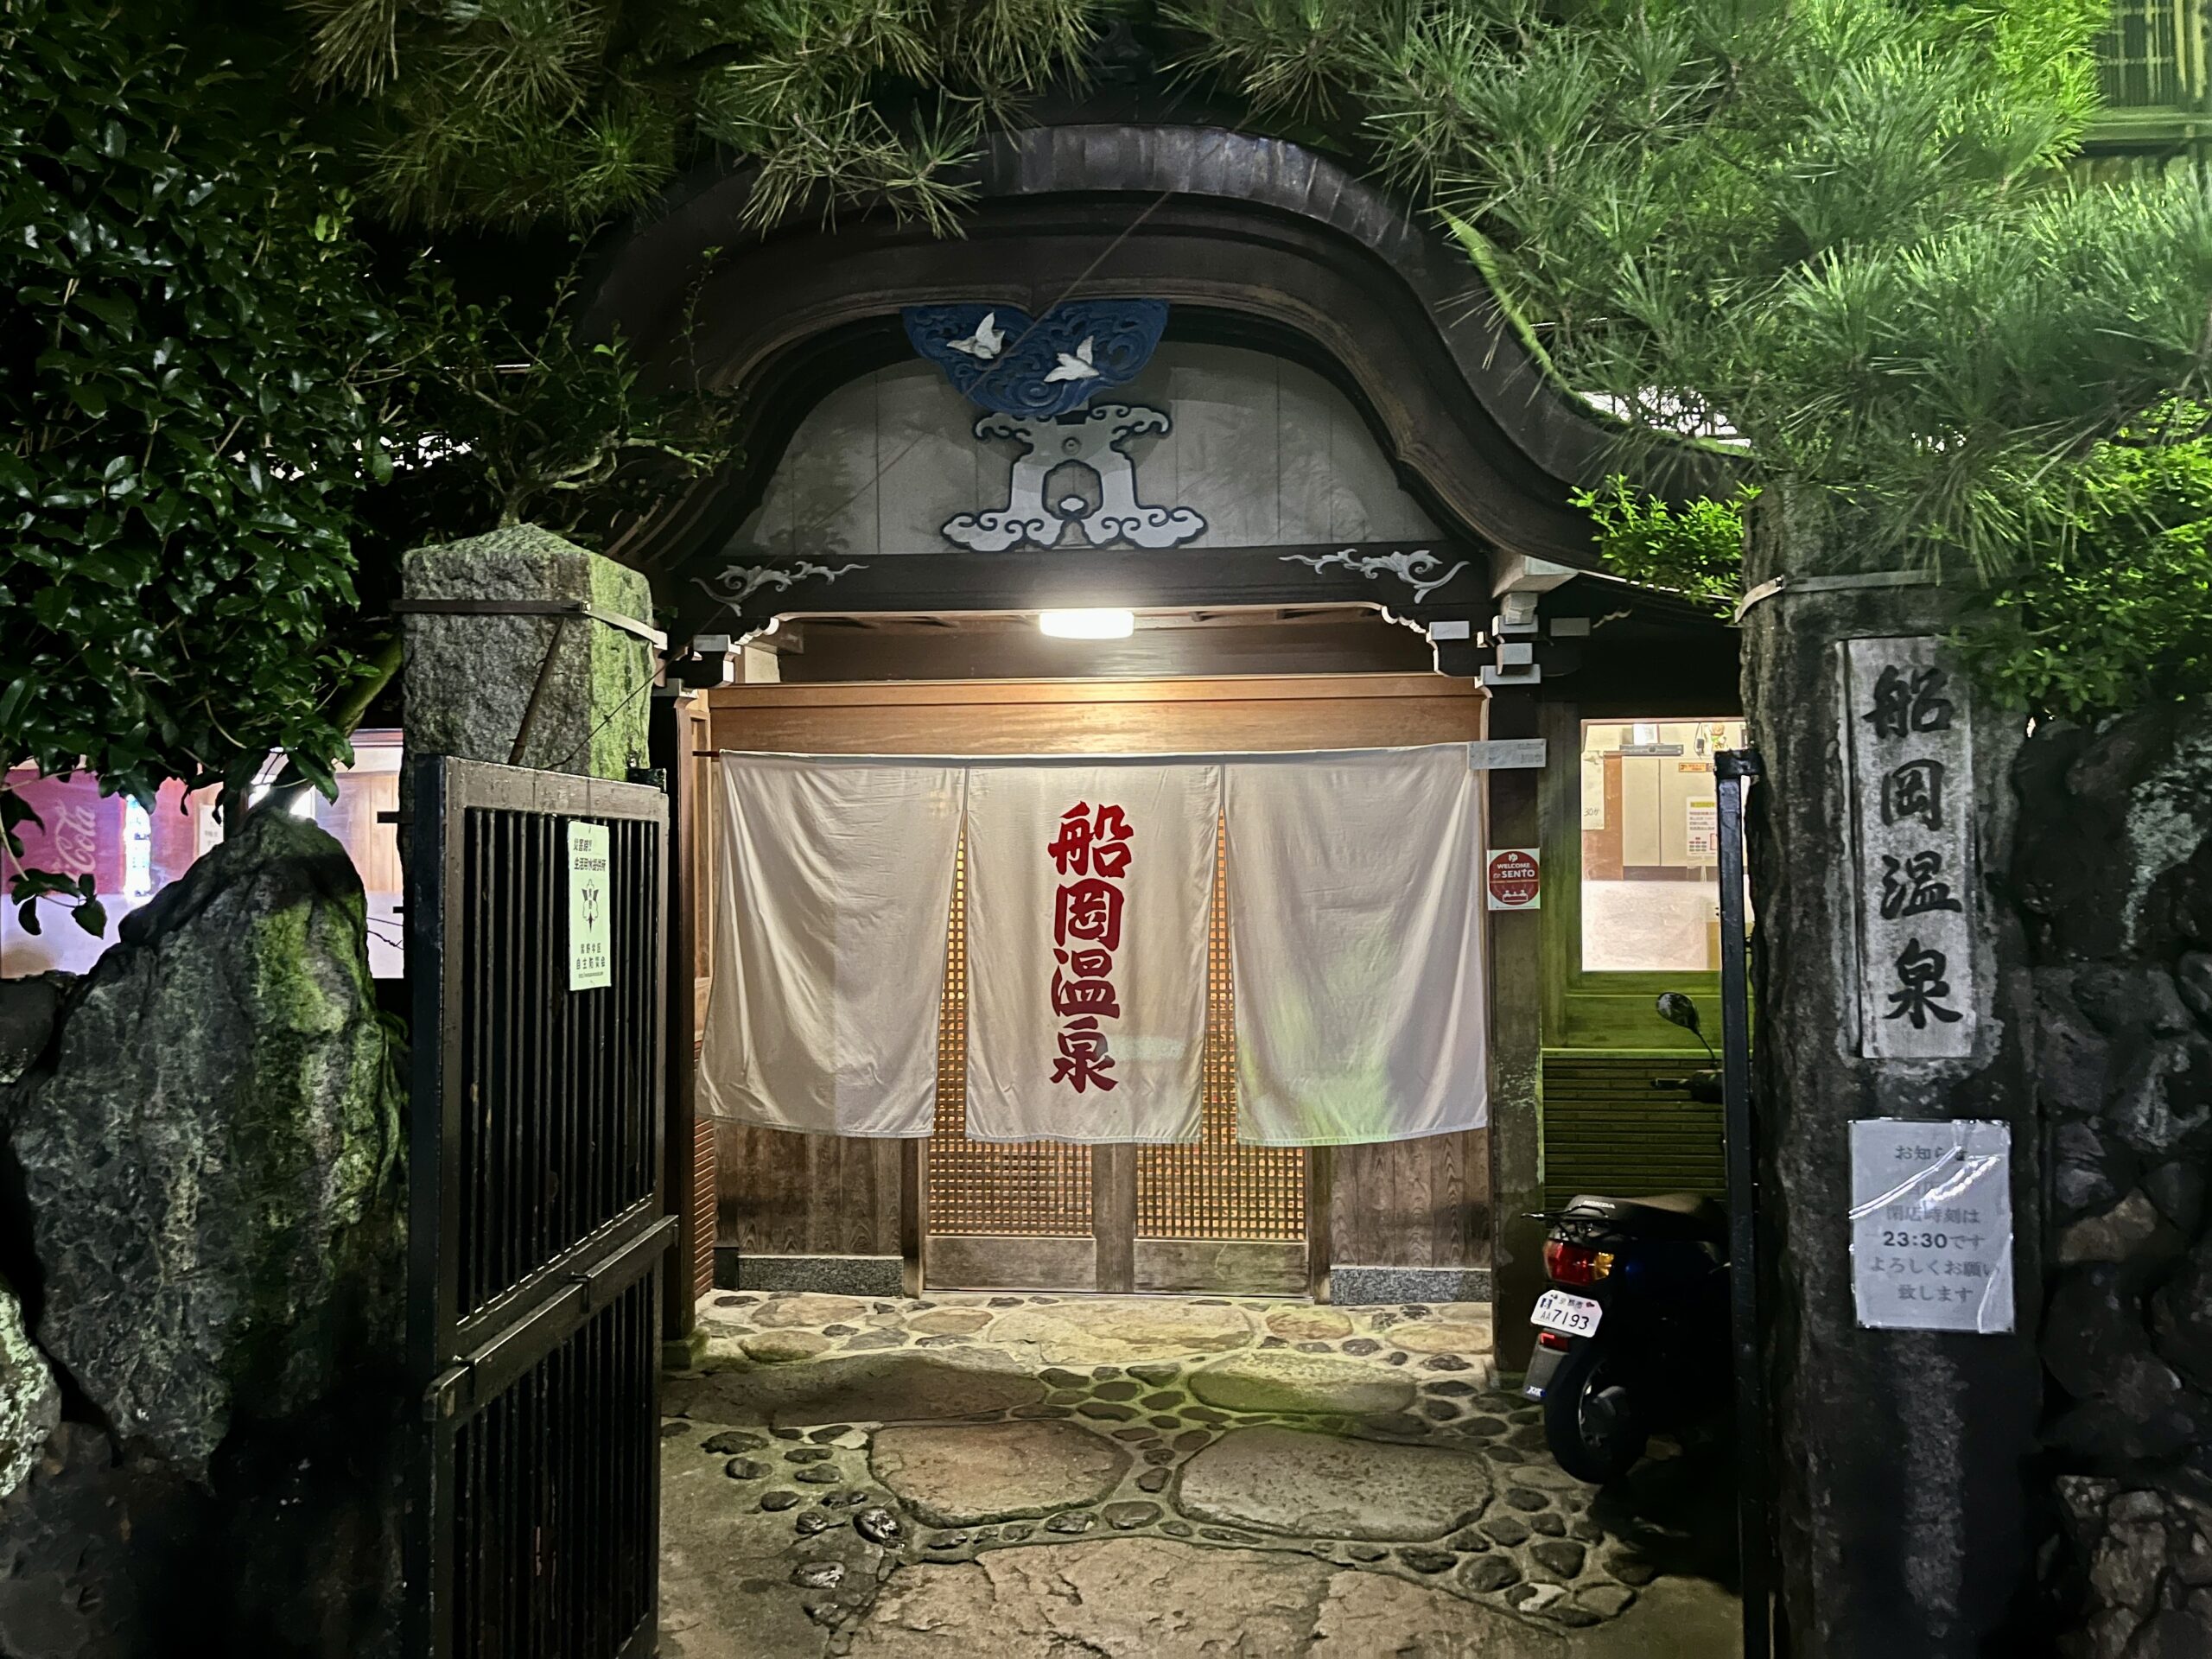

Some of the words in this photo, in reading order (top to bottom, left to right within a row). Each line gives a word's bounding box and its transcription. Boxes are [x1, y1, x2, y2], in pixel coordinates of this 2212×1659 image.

[1502, 868, 1535, 879] SENTO
[1862, 664, 1964, 1030] 船岡温泉
[1047, 800, 1135, 1094] 船岡温泉
[1552, 1308, 1590, 1330] 7193
